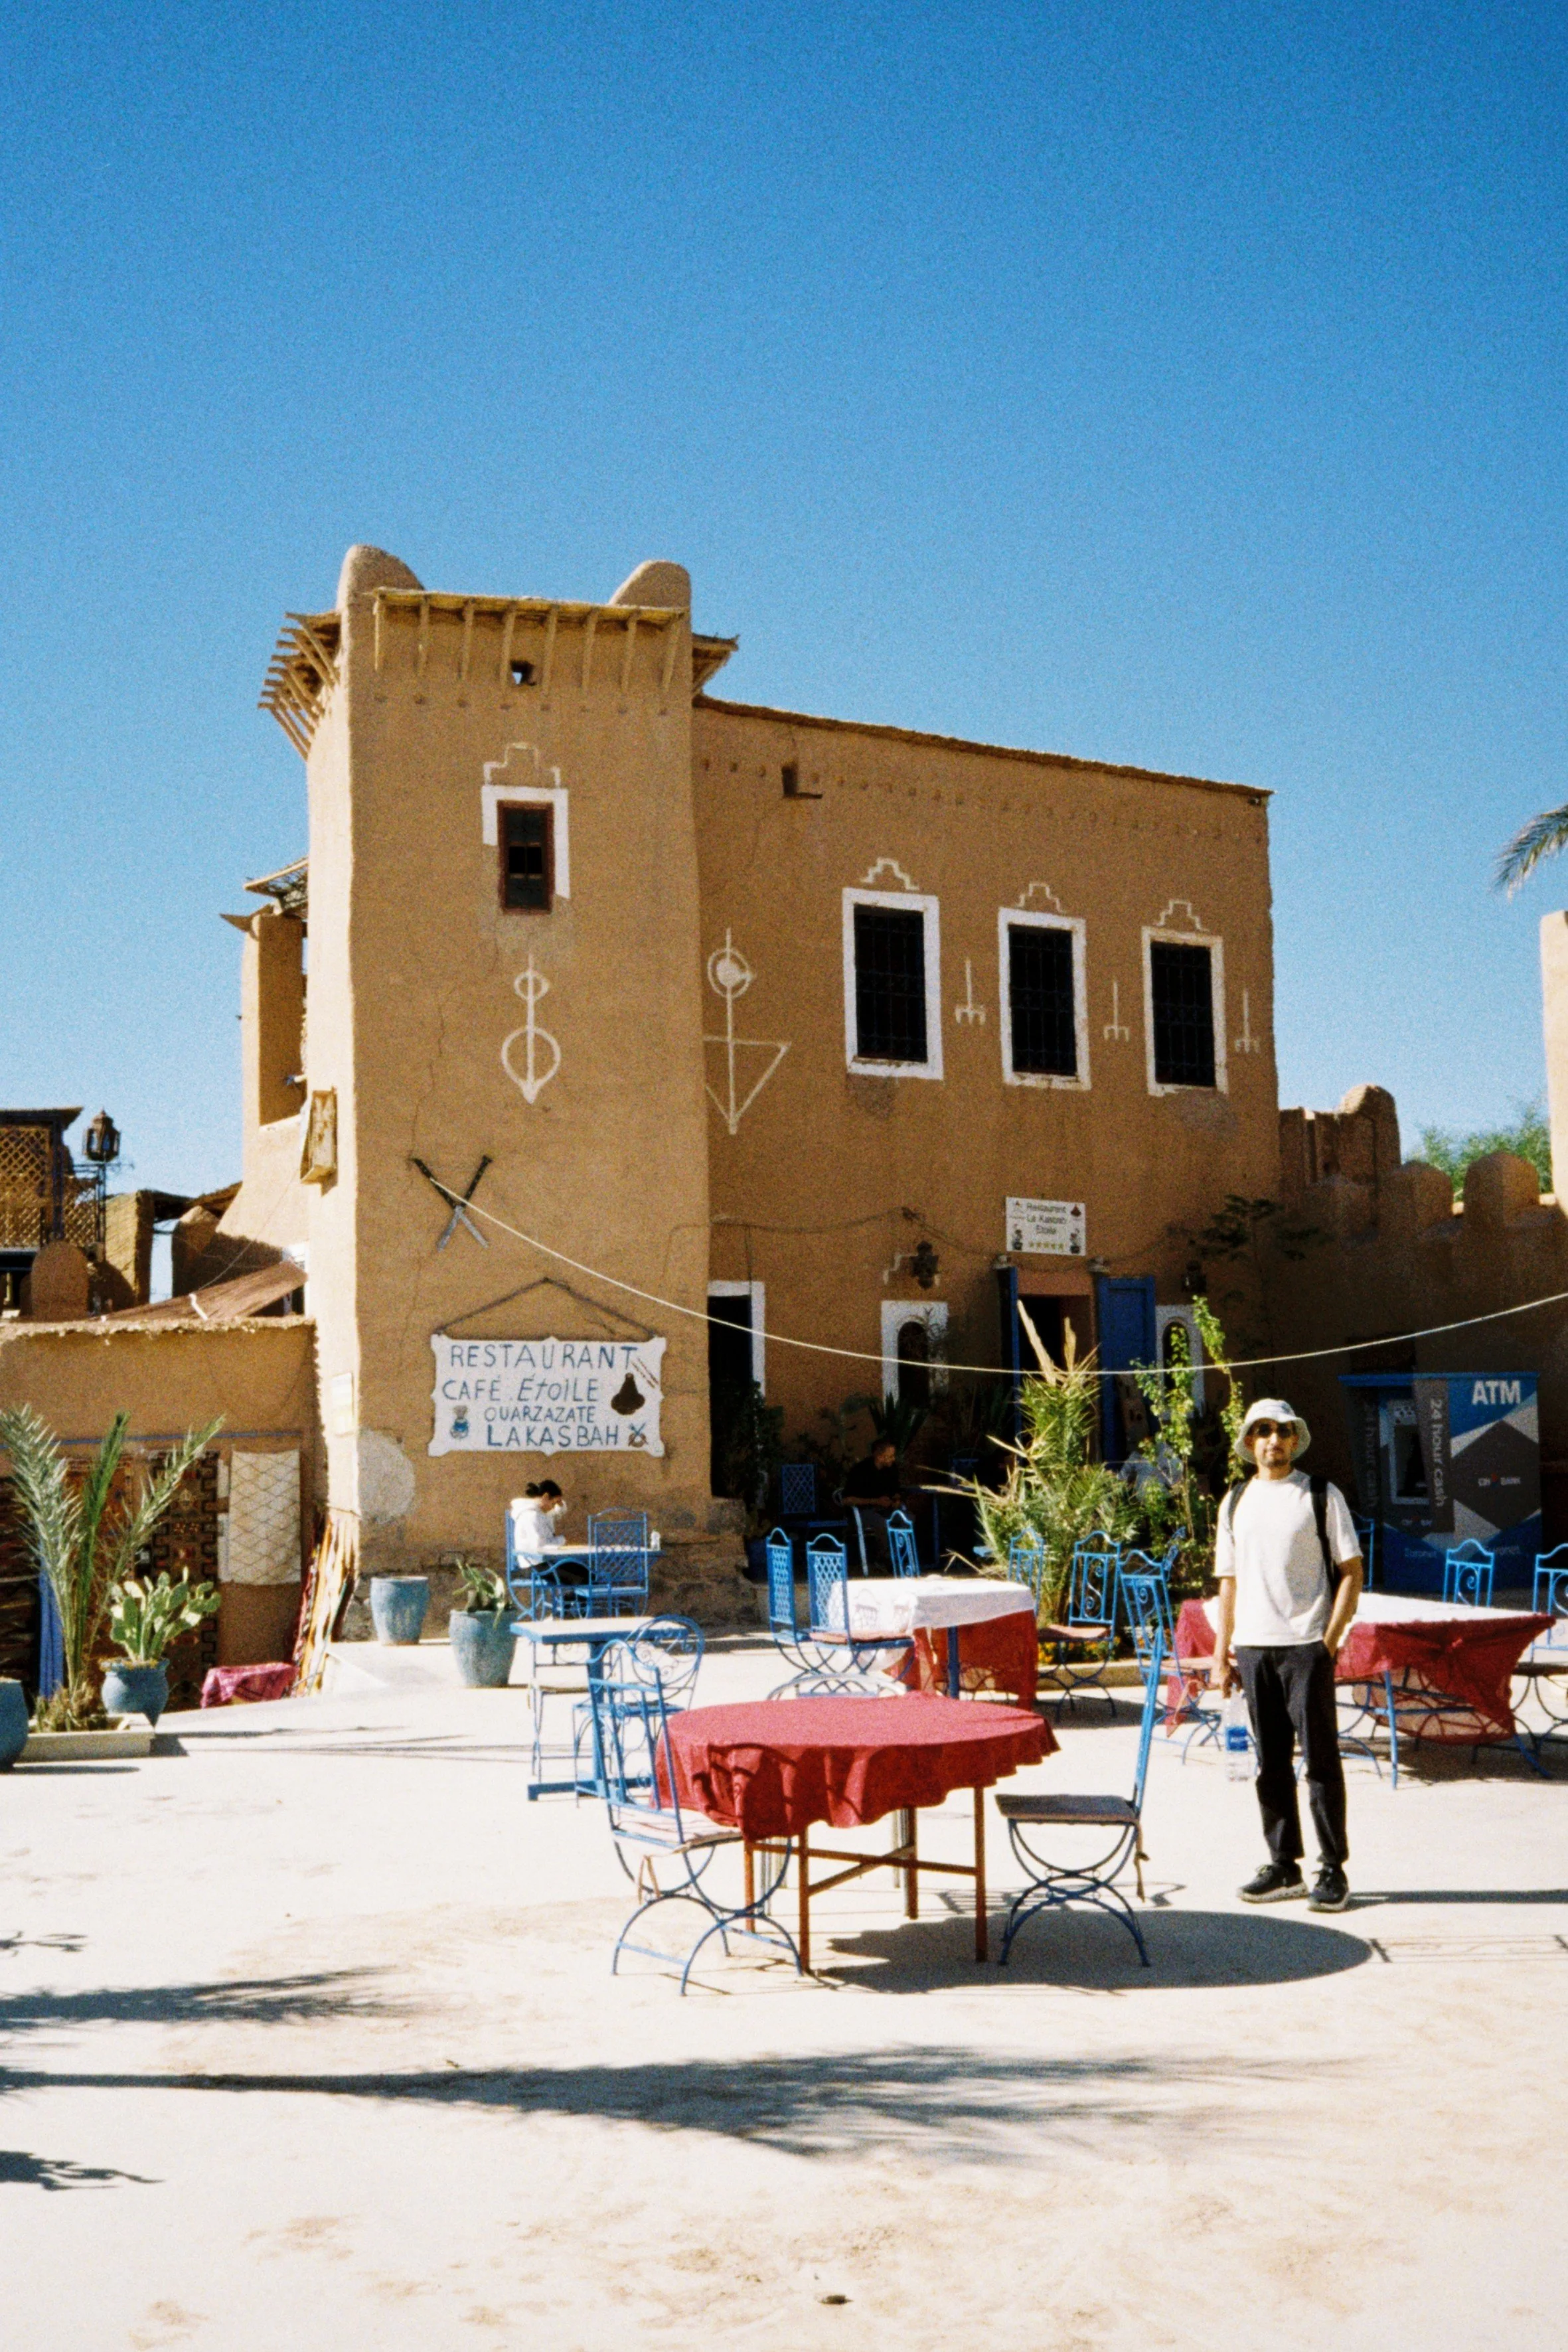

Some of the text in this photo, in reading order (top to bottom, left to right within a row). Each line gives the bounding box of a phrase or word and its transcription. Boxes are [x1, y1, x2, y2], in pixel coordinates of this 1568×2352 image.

[450, 1344, 638, 1371] RESTAURANT
[442, 1374, 501, 1401] CAFÉ
[1472, 1380, 1522, 1405] ATM
[484, 1405, 596, 1423] OUARZAZATE
[487, 1423, 619, 1448] LAKASBAH
[1430, 1398, 1449, 1508] 24 hour cash
